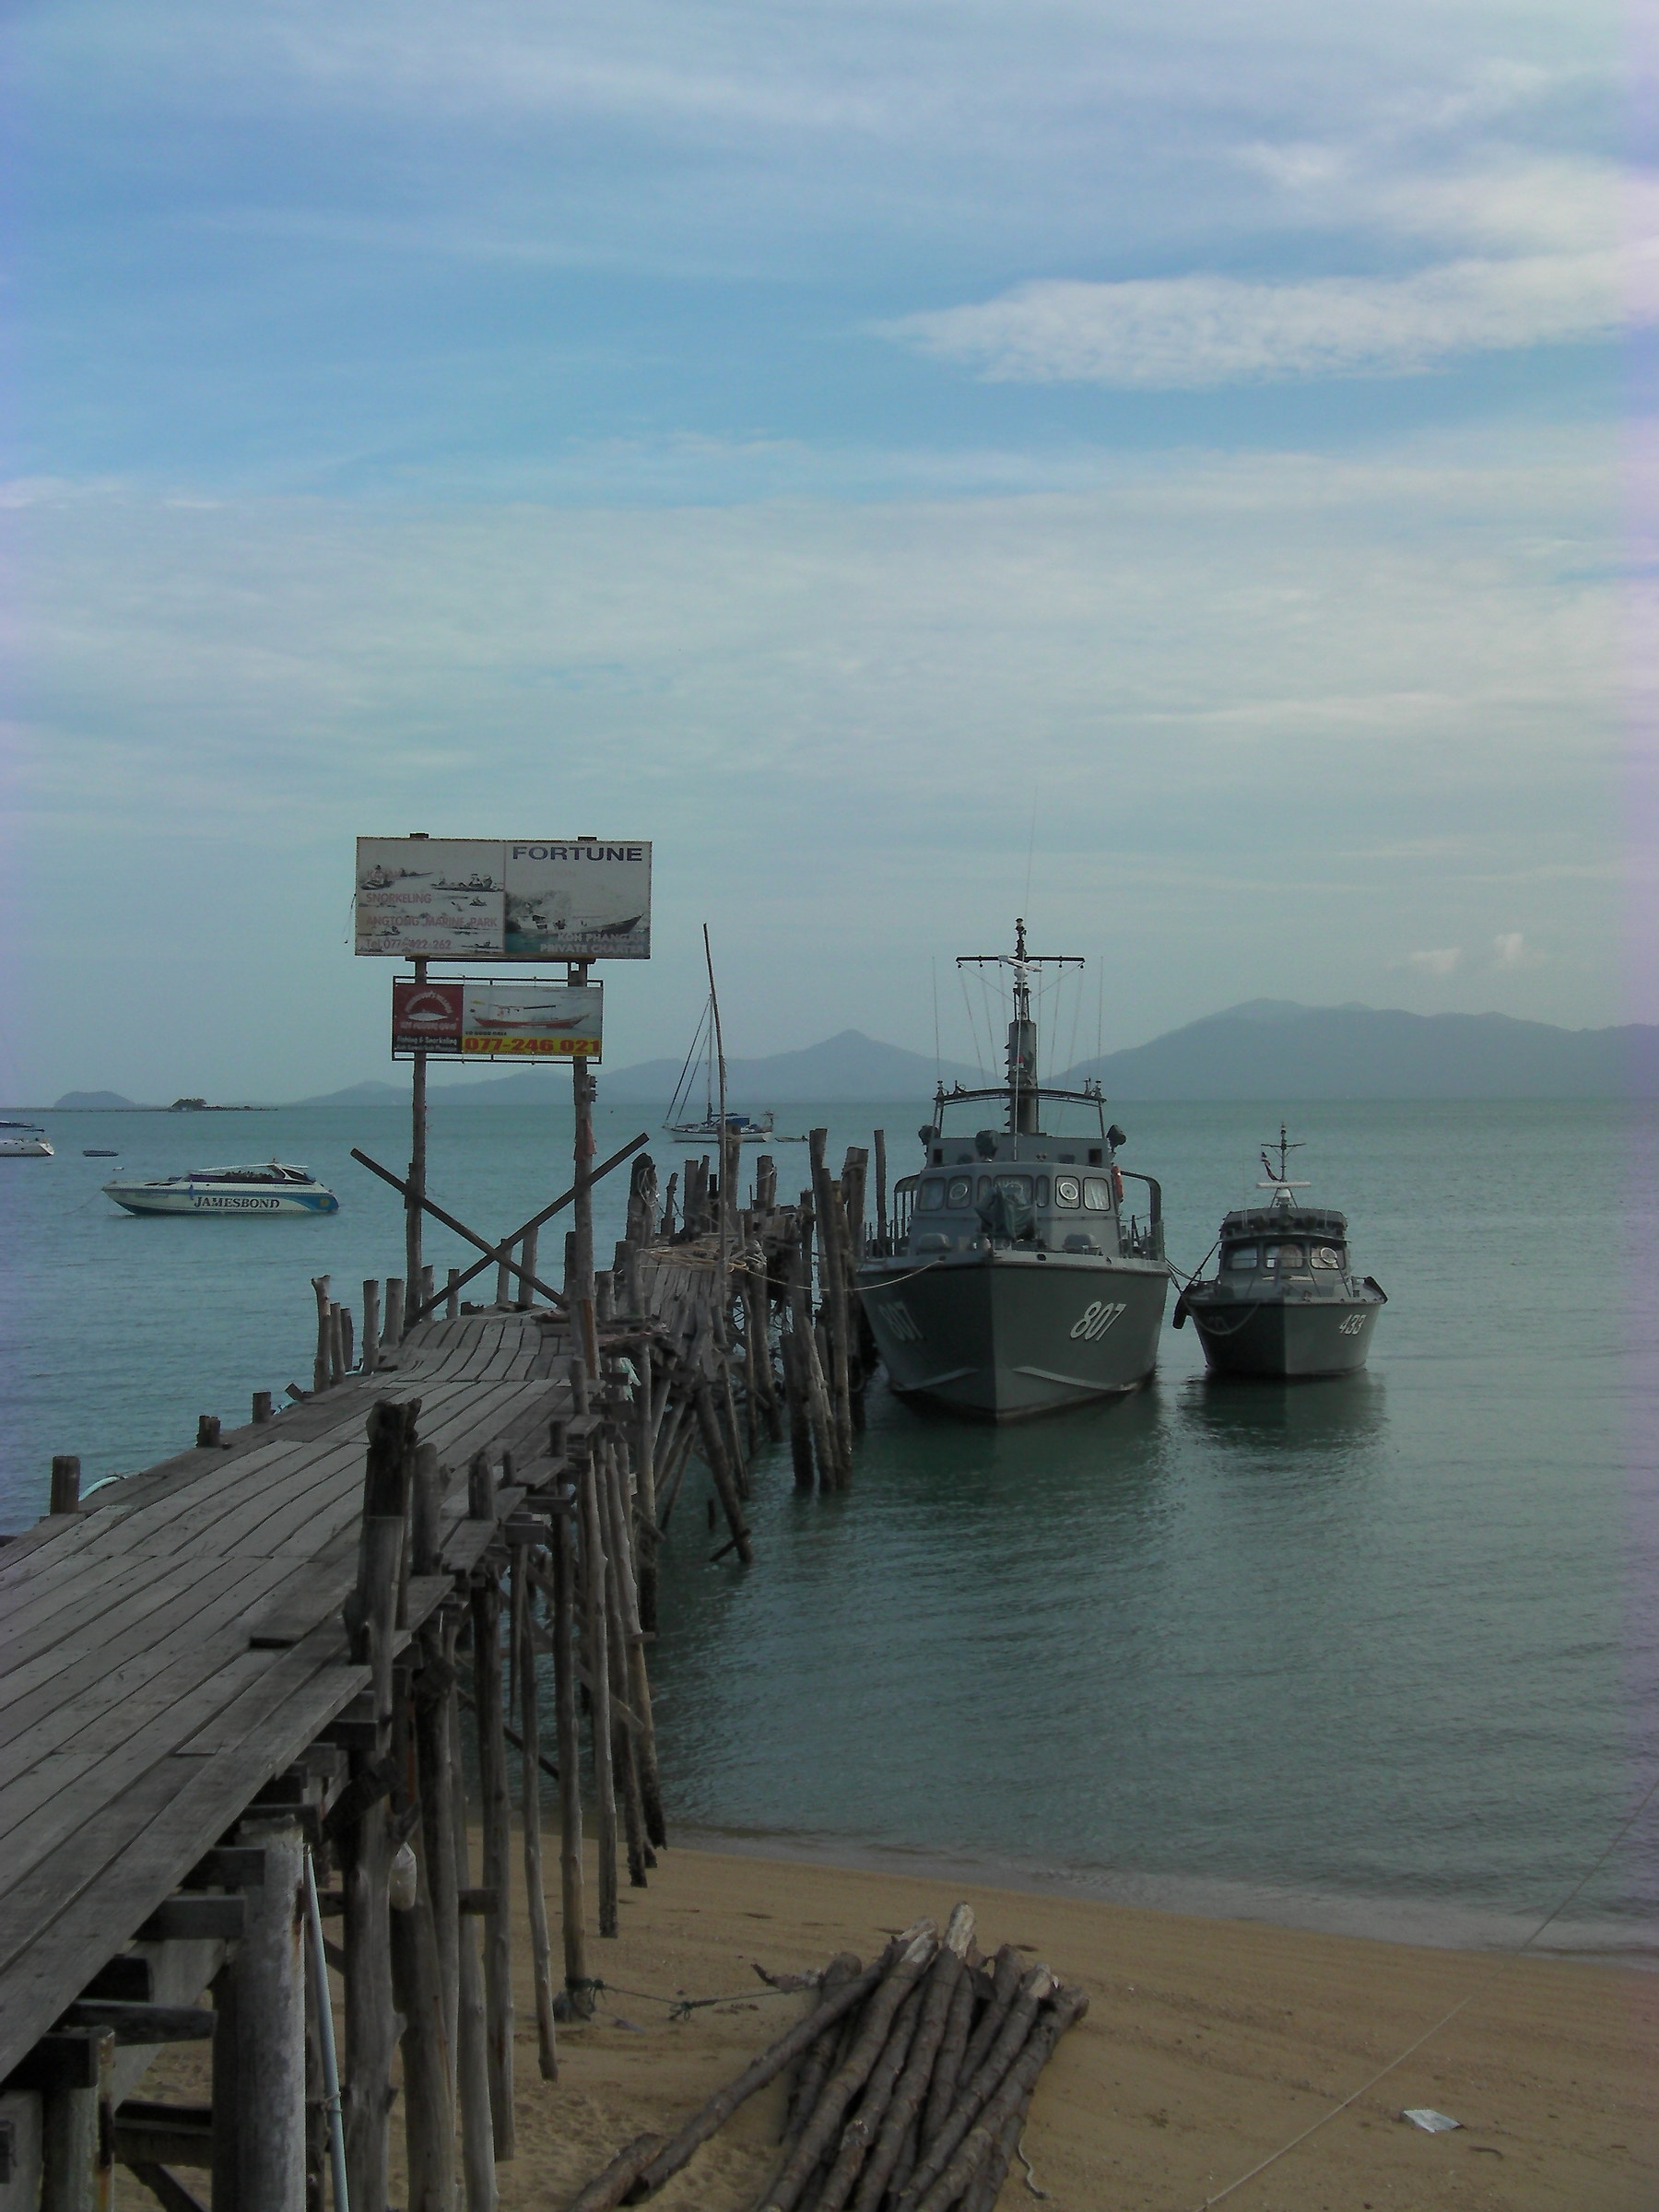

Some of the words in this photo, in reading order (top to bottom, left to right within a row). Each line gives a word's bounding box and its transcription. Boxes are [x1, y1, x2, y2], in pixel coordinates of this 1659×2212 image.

[512, 846, 642, 861] FORTUNE
[366, 892, 431, 904] SNORKELING
[366, 915, 419, 926] ANGTONG
[425, 916, 465, 927] MARINE
[471, 917, 498, 927] PARK
[540, 944, 588, 953] PRIVATE
[591, 944, 644, 954] CHARTER
[465, 1038, 555, 1052] 077-246
[559, 1040, 600, 1052] 021
[194, 1196, 280, 1208] JAMESBOND
[878, 1300, 924, 1341] 807
[1069, 1300, 1127, 1342] 807
[1339, 1314, 1367, 1335] 433
